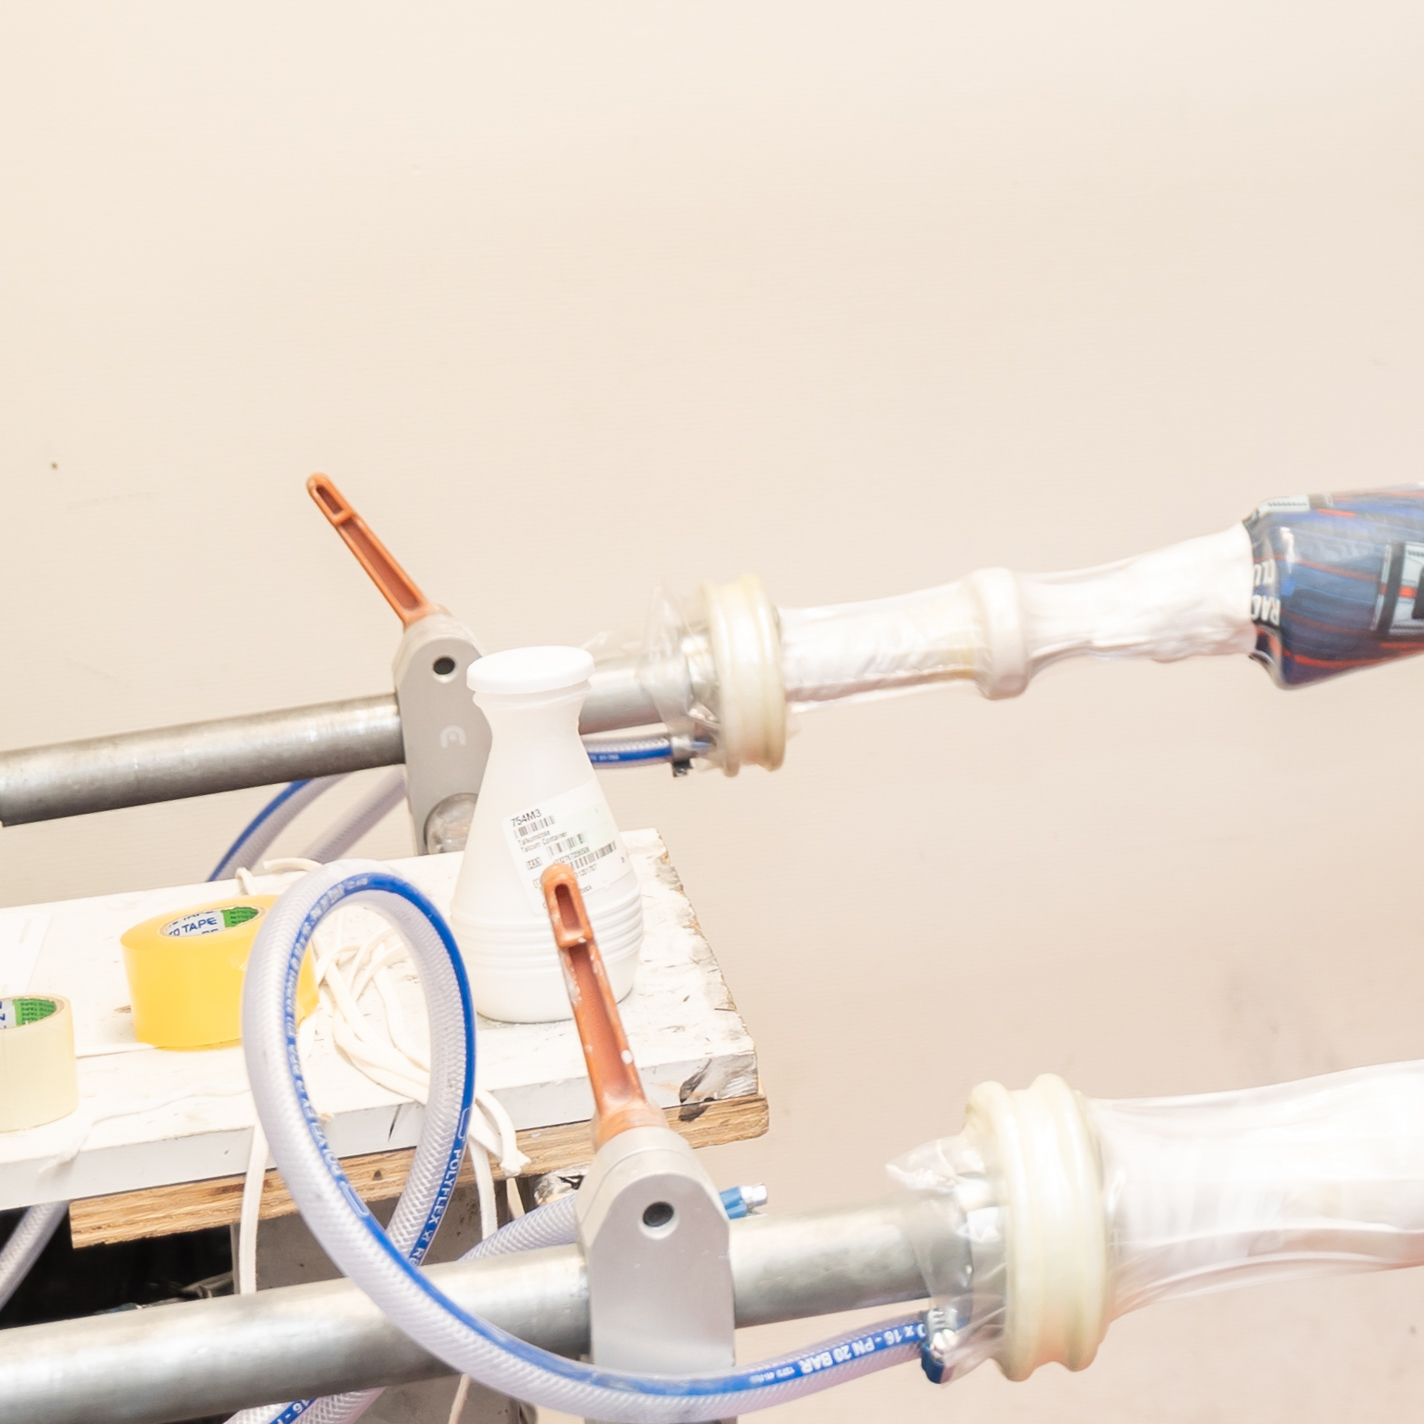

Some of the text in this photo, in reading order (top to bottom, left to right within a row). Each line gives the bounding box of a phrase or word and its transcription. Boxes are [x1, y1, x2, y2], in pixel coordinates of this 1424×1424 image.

[511, 808, 542, 828] 754M3
[181, 917, 218, 934] TAPE
[427, 1148, 463, 1225] POLYFLEX
[883, 1326, 903, 1346] 16
[832, 1344, 852, 1364] 20
[851, 1337, 876, 1356] PN
[797, 1351, 833, 1374] BAR
